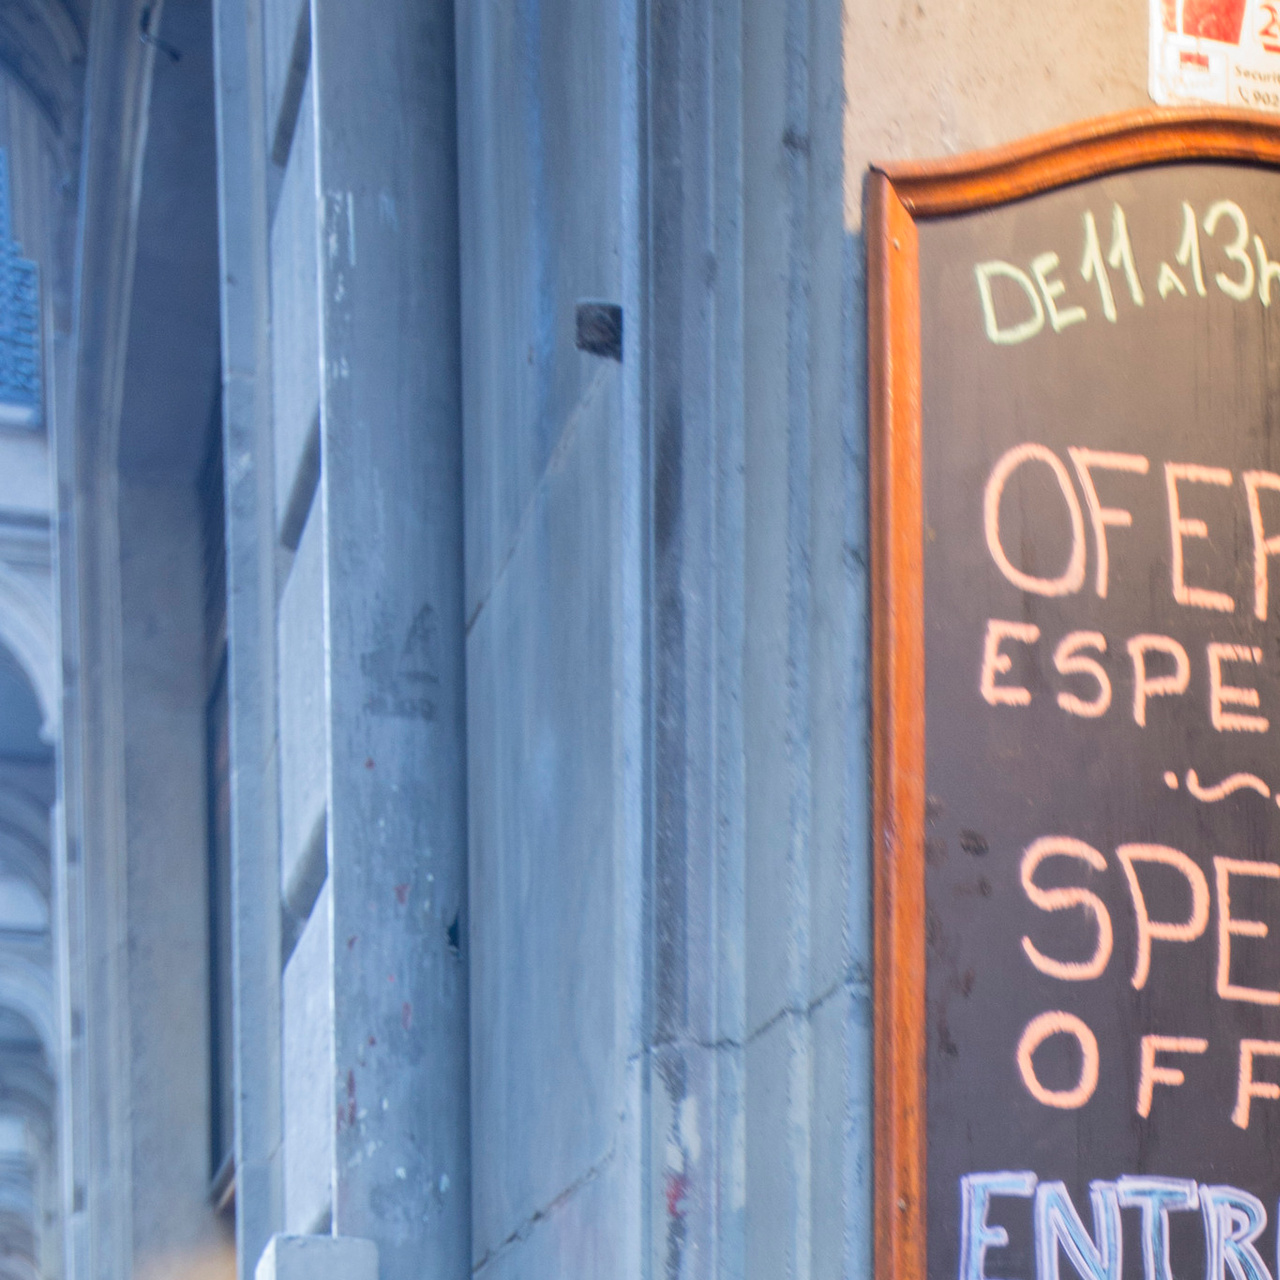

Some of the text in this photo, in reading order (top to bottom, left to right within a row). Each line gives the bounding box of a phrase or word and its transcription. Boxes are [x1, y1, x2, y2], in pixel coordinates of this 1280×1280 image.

[1253, 91, 1280, 108] 902
[975, 253, 1086, 345] DE
[1080, 203, 1144, 324] 11
